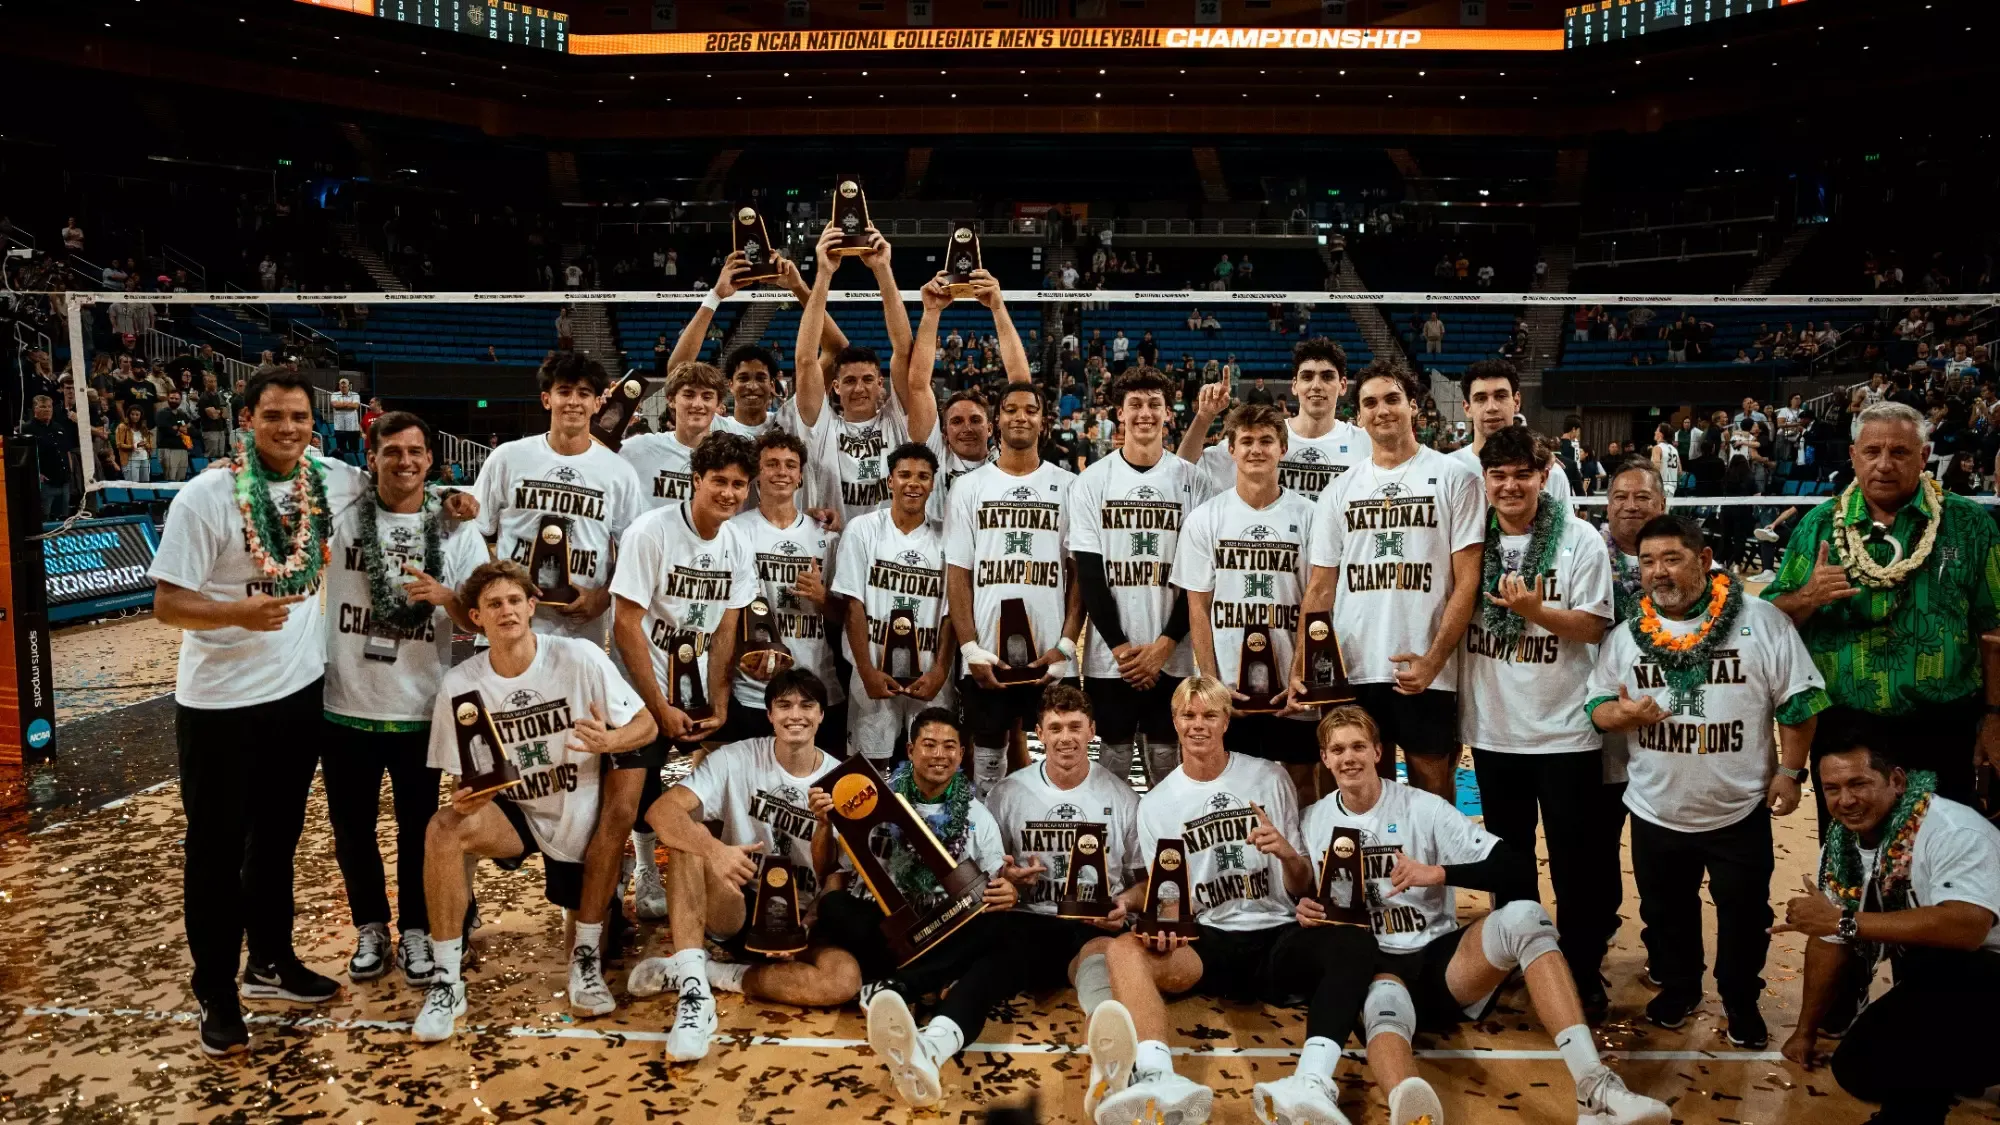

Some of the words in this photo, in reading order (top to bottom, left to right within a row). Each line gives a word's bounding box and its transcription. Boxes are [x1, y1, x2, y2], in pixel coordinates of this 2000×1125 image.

[504, 2, 518, 12] KILL
[656, 10, 671, 20] 42
[914, 6, 926, 16] 31
[1200, 4, 1216, 14] 32
[1468, 6, 1478, 15] 11
[1566, 7, 1577, 17] PLY
[1582, 4, 1596, 14] KILL
[1684, 4, 1692, 14] 13
[398, 12, 404, 20] 13
[454, 23, 458, 32] 2
[558, 22, 562, 32] 0
[1568, 18, 1573, 26] 4
[1586, 14, 1590, 23] 0
[1584, 25, 1592, 34] 15
[1604, 22, 1608, 31] 7
[525, 26, 530, 35] 7
[556, 32, 564, 42] 32
[525, 36, 530, 46] 7
[558, 43, 562, 52] 0
[705, 33, 752, 51] 2026
[757, 32, 801, 50] NCAA
[806, 31, 888, 50] NATIONAL
[893, 29, 992, 49] COLLEGIATE
[998, 28, 1053, 48] MEN'S
[1059, 28, 1160, 47] VOLLEYBALL
[1166, 28, 1422, 49] CHAMPIONSHIP
[1586, 36, 1590, 46] 7
[1278, 468, 1339, 492] ATION
[516, 488, 605, 521] NATIONAL
[978, 507, 1060, 532] NATIONAL
[1102, 508, 1182, 530] NATIONAL
[1345, 504, 1438, 532] NATIONAL
[44, 552, 106, 574] OLLEYBALL
[1216, 550, 1299, 572] NATIONAL
[46, 564, 146, 596] IONSHIP
[665, 572, 732, 600] NATIONAL
[30, 630, 38, 663] sports
[32, 664, 42, 708] imports
[30, 730, 51, 742] NCAA
[494, 713, 576, 744] ATIONAL
[840, 784, 877, 814] NCAA
[748, 796, 814, 842] NATIONA
[1182, 816, 1261, 854] NATIONA
[1160, 858, 1180, 866] NCAA
[913, 918, 942, 943] NATIONAL
